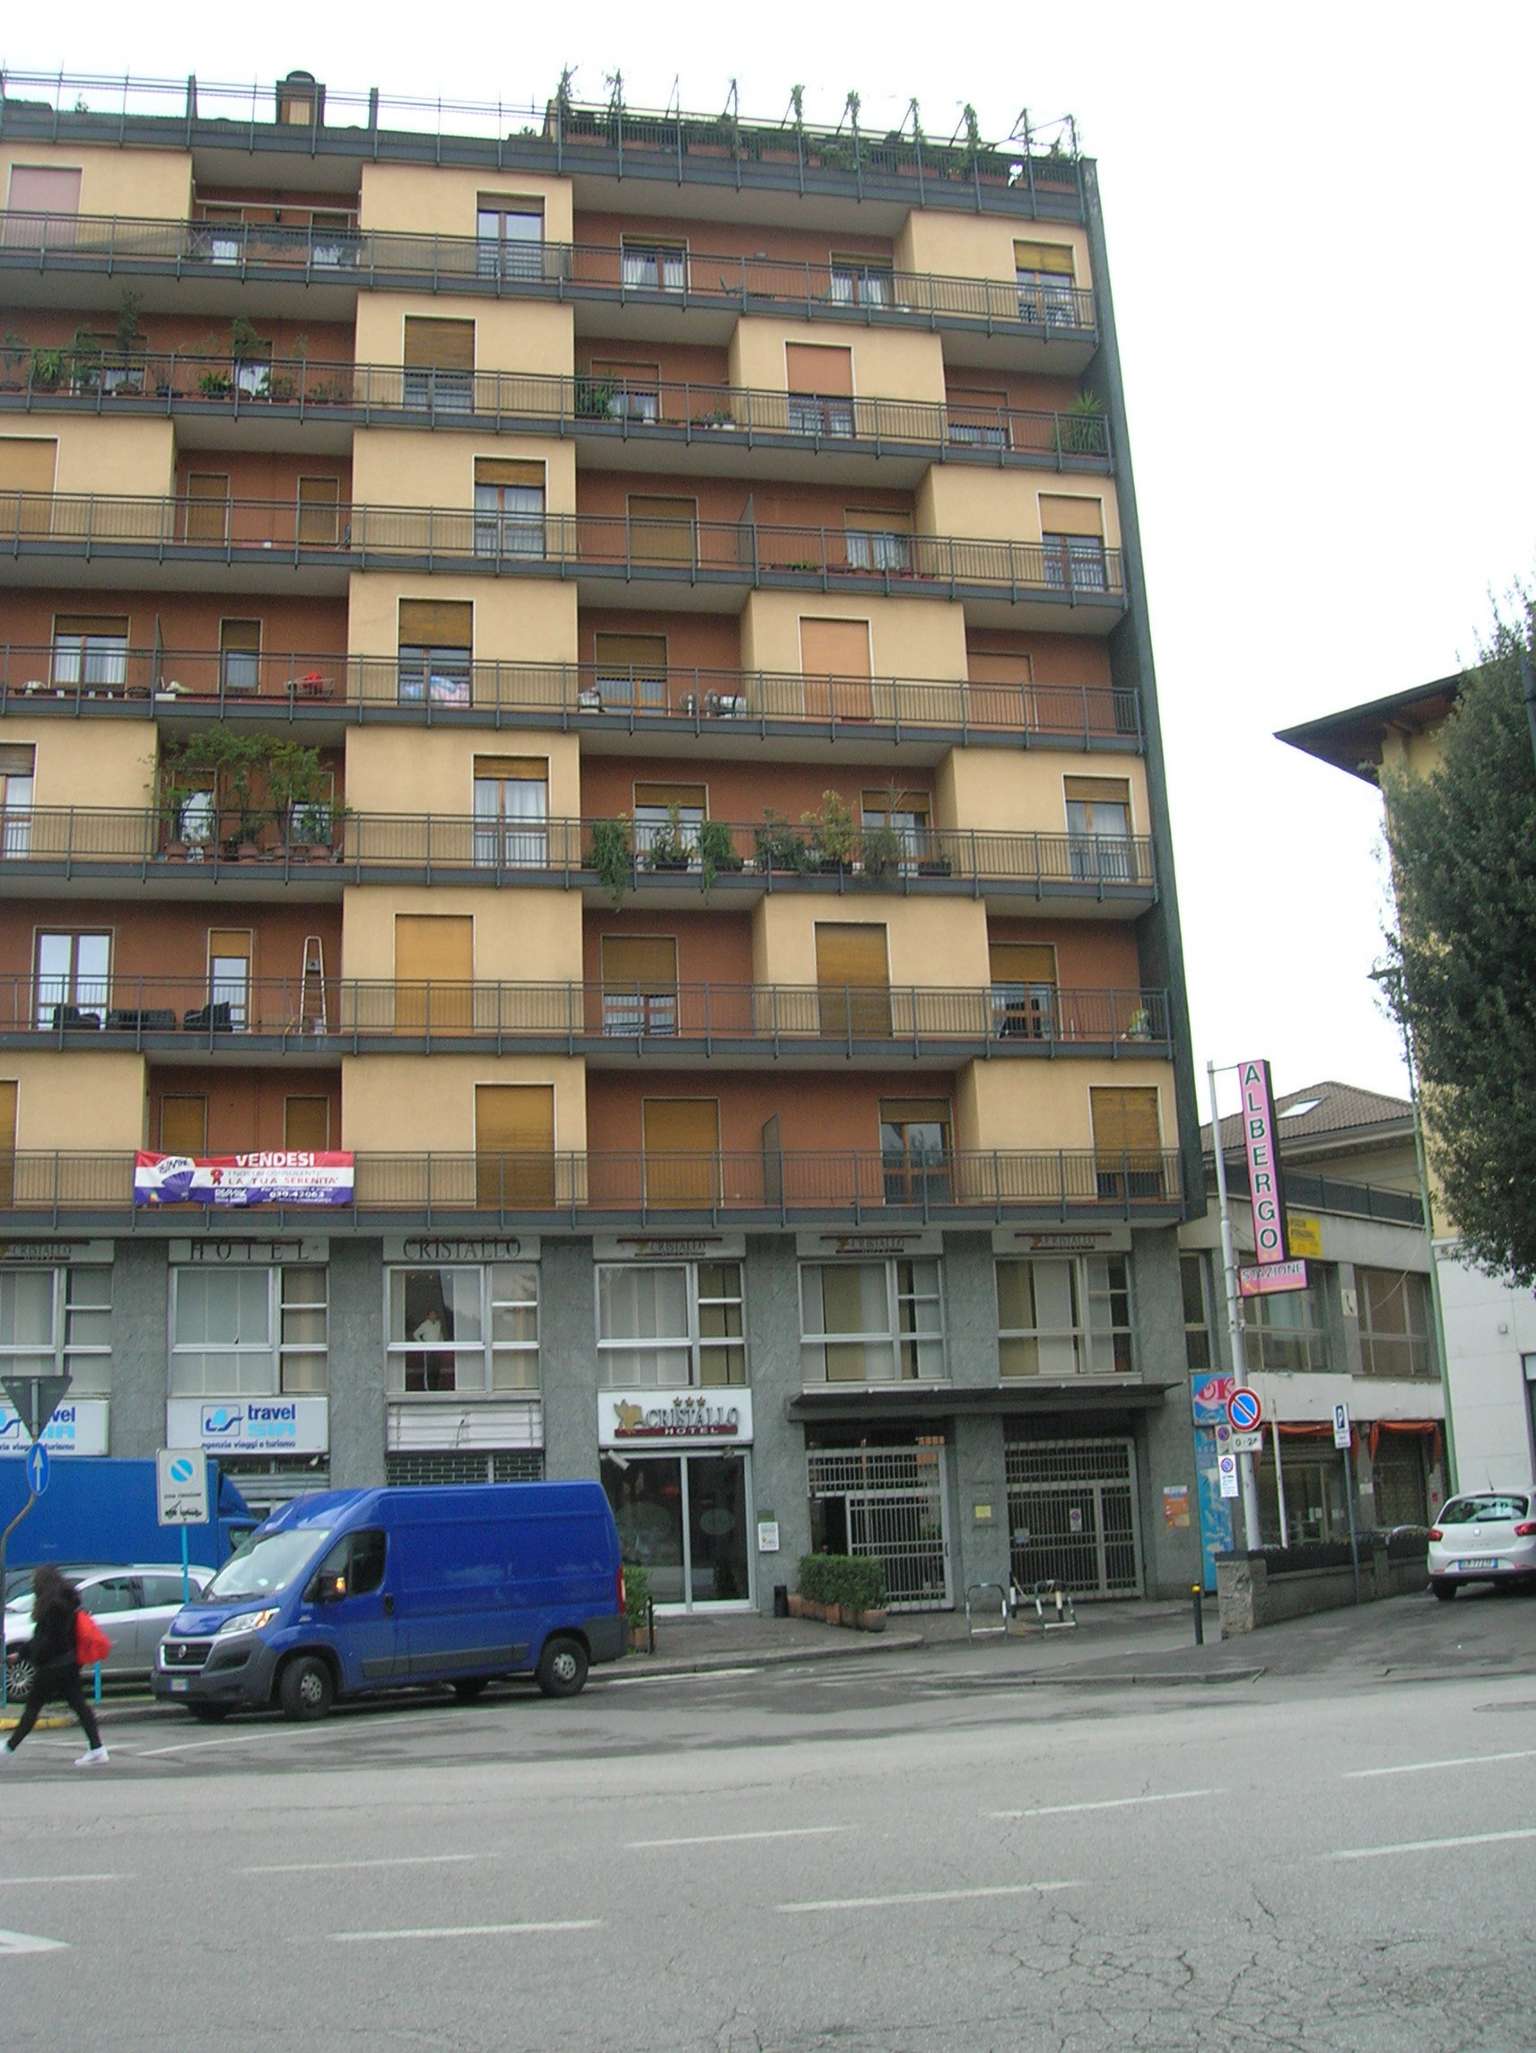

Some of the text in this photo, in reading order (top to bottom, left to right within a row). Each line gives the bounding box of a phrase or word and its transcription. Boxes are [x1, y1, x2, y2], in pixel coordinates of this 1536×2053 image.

[235, 1152, 315, 1167] VENDESI
[1244, 1064, 1278, 1249] ALBERGO
[191, 1238, 309, 1261] HOTEL
[403, 1237, 521, 1259] CRISTALLO
[248, 1403, 296, 1420] travel
[645, 1407, 739, 1427] CRISTALLO
[665, 1427, 719, 1435] HOTEL
[233, 1439, 258, 1450] viaggi
[266, 1439, 296, 1448] turismo
